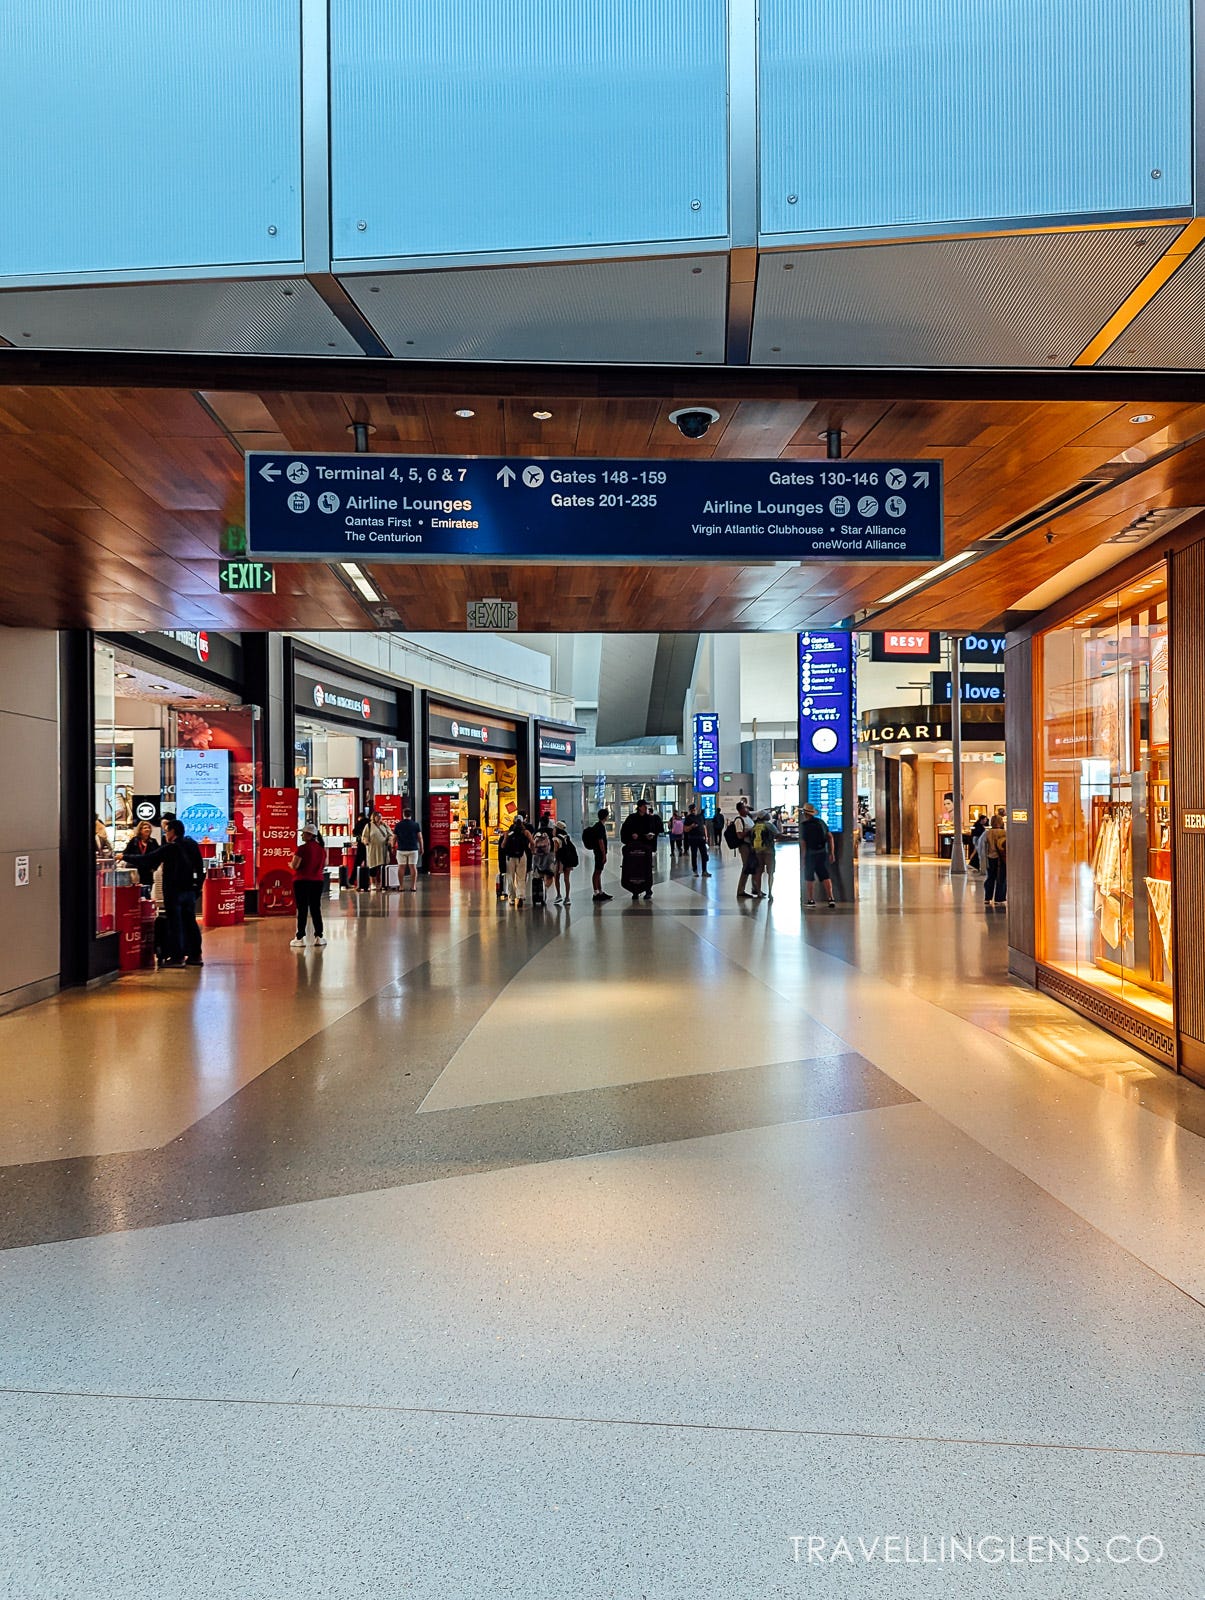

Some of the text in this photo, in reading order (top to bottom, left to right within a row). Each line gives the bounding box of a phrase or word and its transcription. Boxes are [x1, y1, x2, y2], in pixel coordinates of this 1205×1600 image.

[315, 466, 467, 484] Terminal 4, 5, 6 & 7
[550, 469, 597, 484] Gates
[769, 471, 879, 486] Gates 130-146
[345, 495, 473, 514] Airline Lounges
[551, 493, 658, 508] Gates 201-235
[702, 500, 824, 517] Airline Lounges
[344, 515, 479, 529] Qantas First Emirates
[344, 530, 422, 543] The Centurion
[691, 524, 907, 536] Virgin Atlantic Clubhouse Star Alliance
[811, 539, 907, 550] oneWorld Alliance
[228, 563, 264, 589] EXIT
[475, 603, 511, 628] EXIT
[890, 635, 926, 648] RESY
[965, 636, 988, 650] Do
[965, 683, 1001, 699] love
[702, 721, 713, 733] B
[262, 831, 296, 839] US$29
